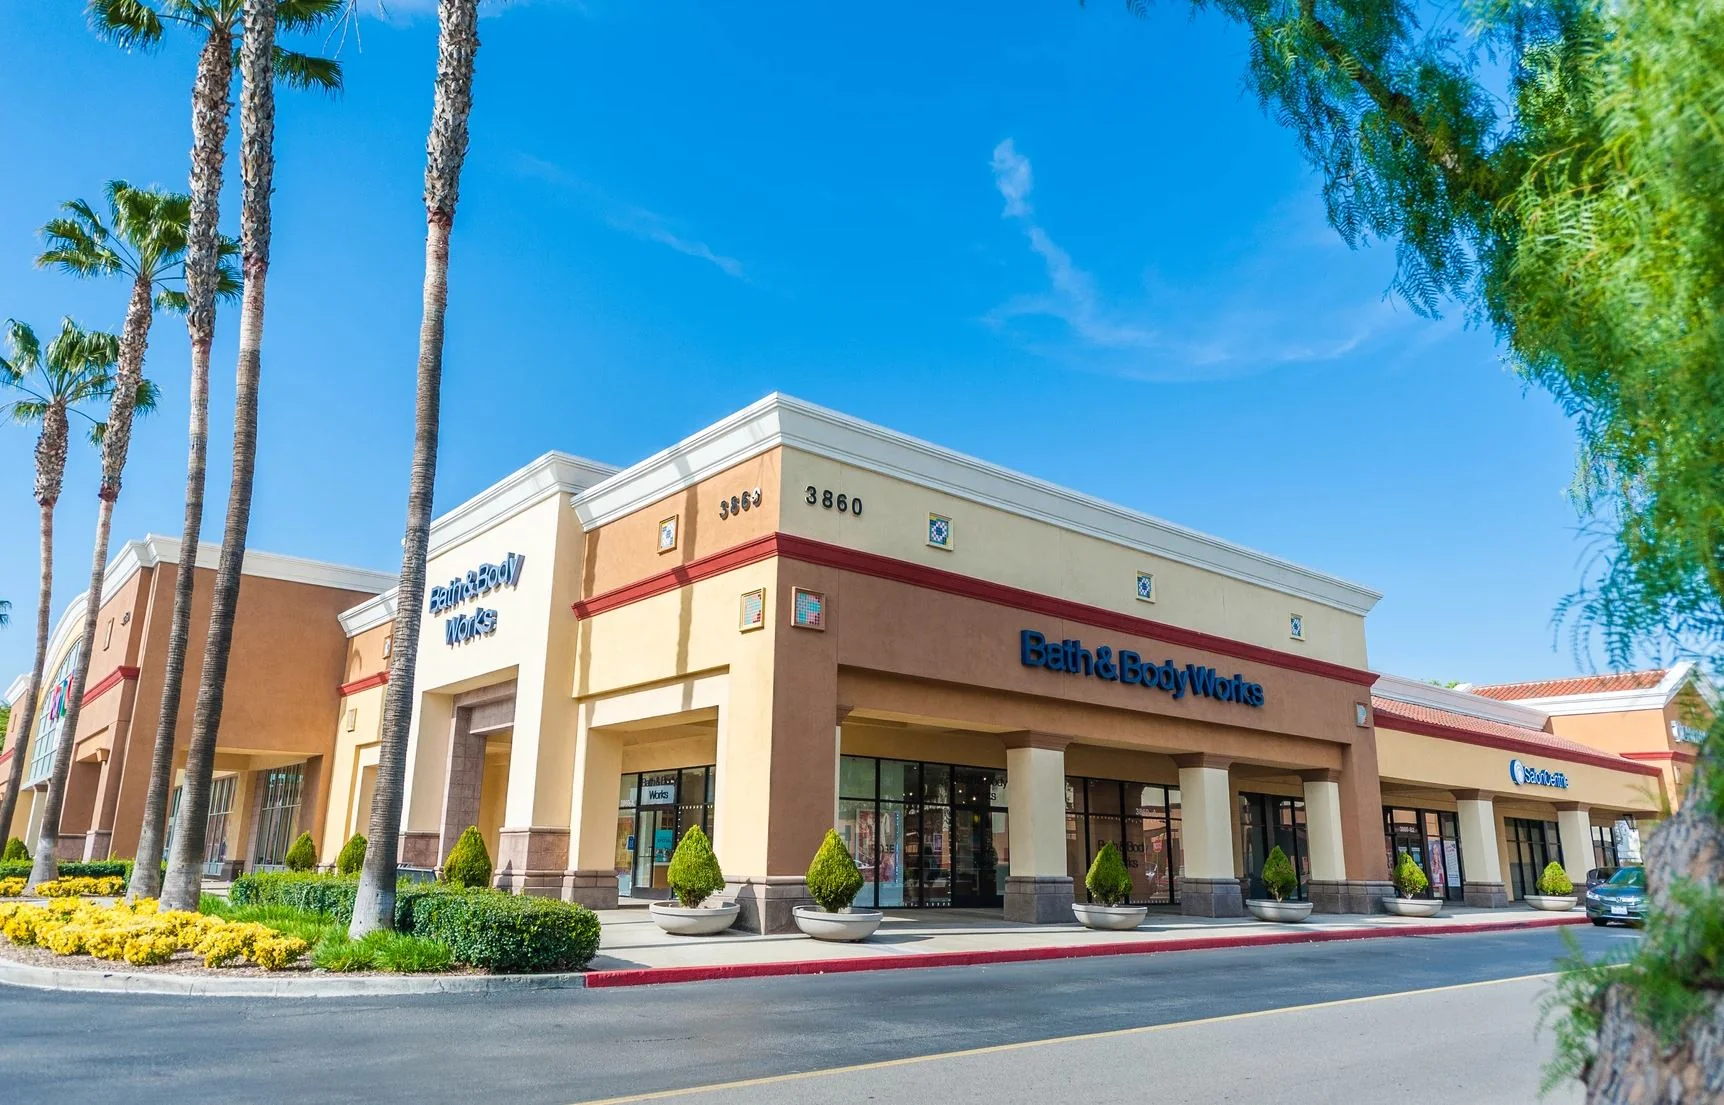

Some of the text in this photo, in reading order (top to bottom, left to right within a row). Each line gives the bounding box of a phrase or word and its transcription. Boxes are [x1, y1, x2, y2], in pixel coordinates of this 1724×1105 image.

[804, 485, 863, 516] 3860
[429, 552, 525, 614] Bath & Body
[446, 607, 498, 645] Works
[1020, 629, 1265, 708] Bath & Body Works
[648, 790, 669, 800] Works
